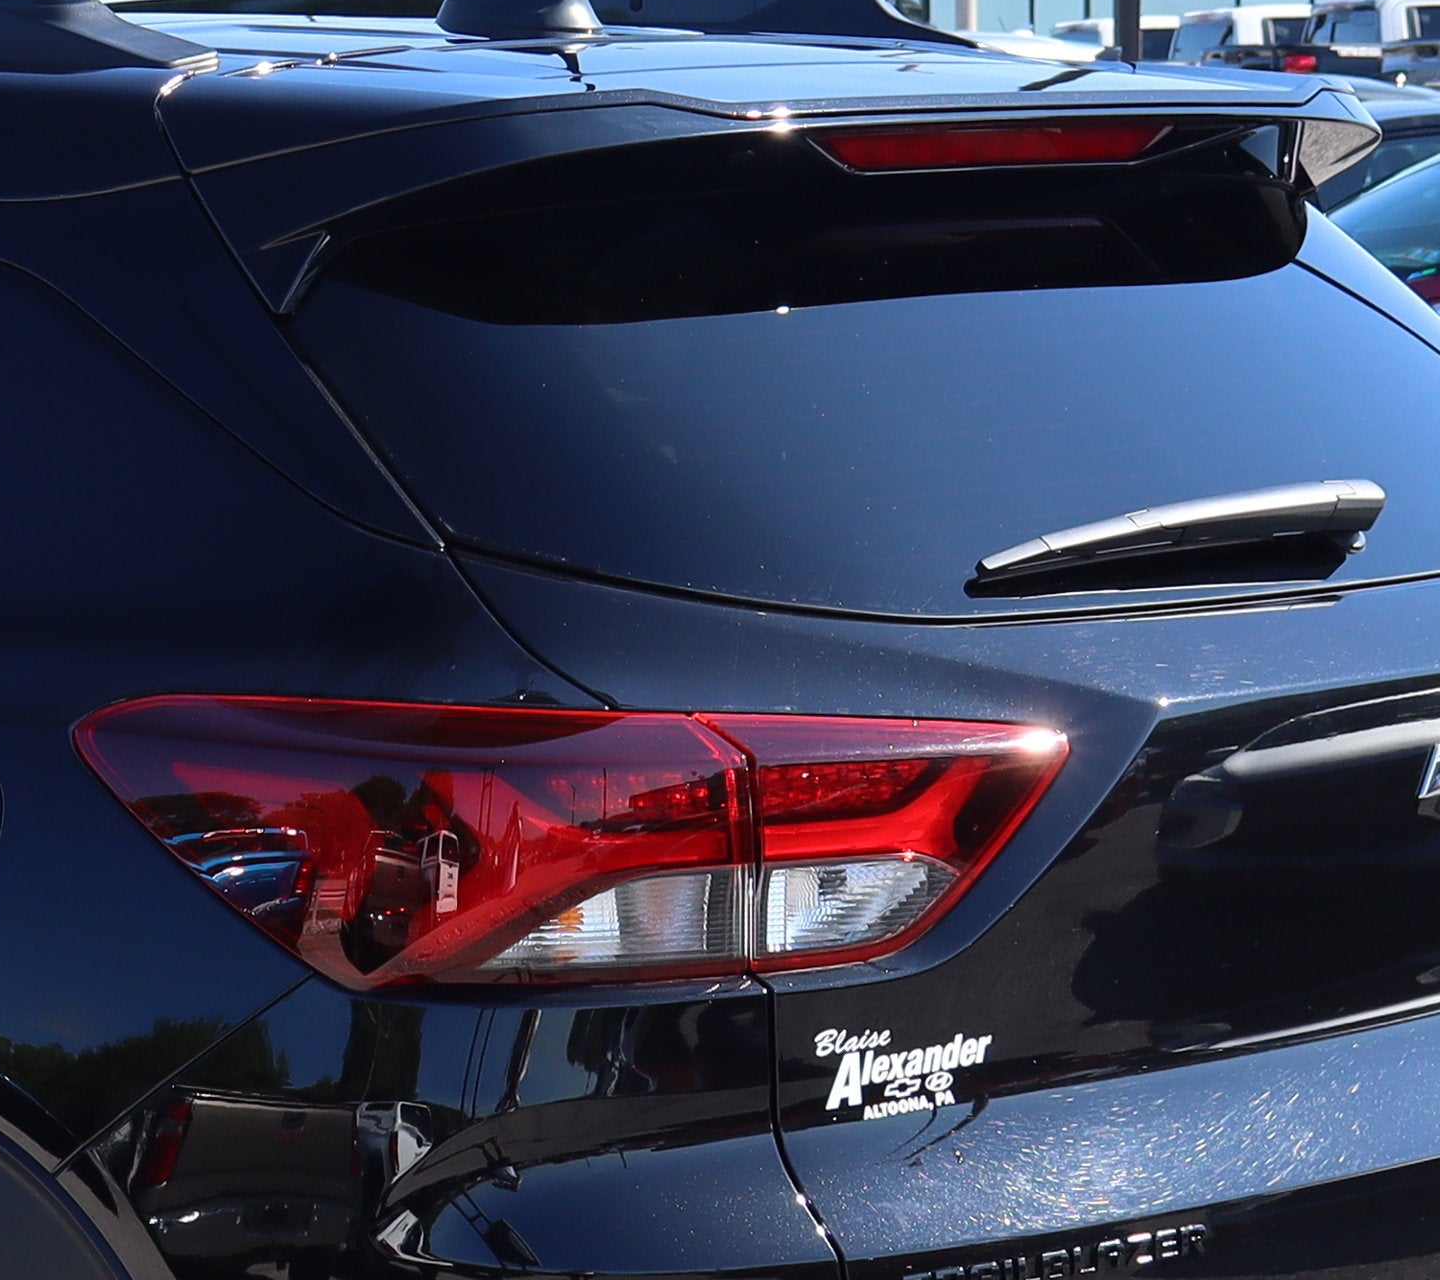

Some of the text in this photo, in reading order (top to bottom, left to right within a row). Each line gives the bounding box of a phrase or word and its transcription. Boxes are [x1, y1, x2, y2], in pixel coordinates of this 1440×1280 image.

[814, 1028, 892, 1057] Blaise
[825, 1032, 993, 1111] Alexander
[863, 1089, 956, 1121] ALTOONA, PA
